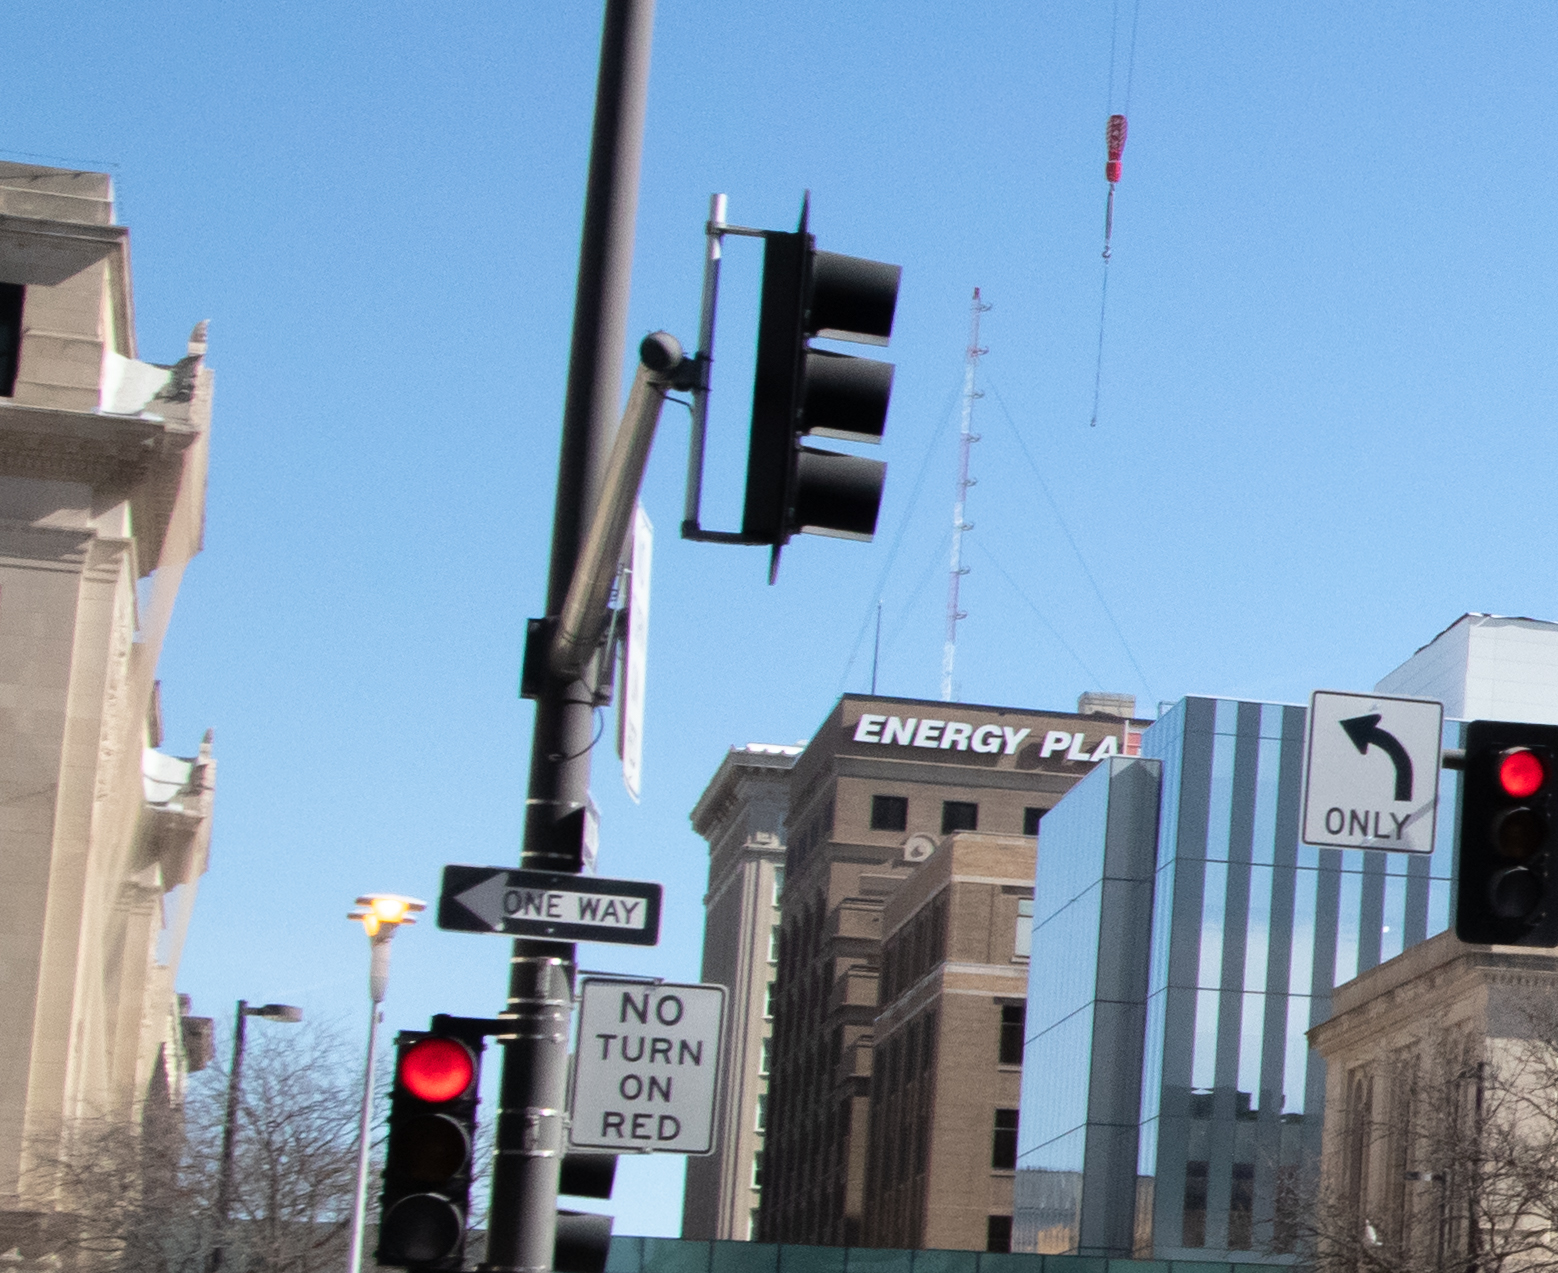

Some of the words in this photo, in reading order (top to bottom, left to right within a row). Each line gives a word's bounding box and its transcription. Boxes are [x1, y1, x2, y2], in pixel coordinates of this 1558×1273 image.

[853, 713, 1031, 755] ENERGY
[1325, 807, 1411, 840] ONLY
[503, 889, 563, 918] ONE
[578, 896, 640, 926] WAY
[619, 991, 684, 1027] NO
[596, 1033, 703, 1067] TURN
[619, 1073, 673, 1103] ON
[601, 1110, 681, 1142] RED
